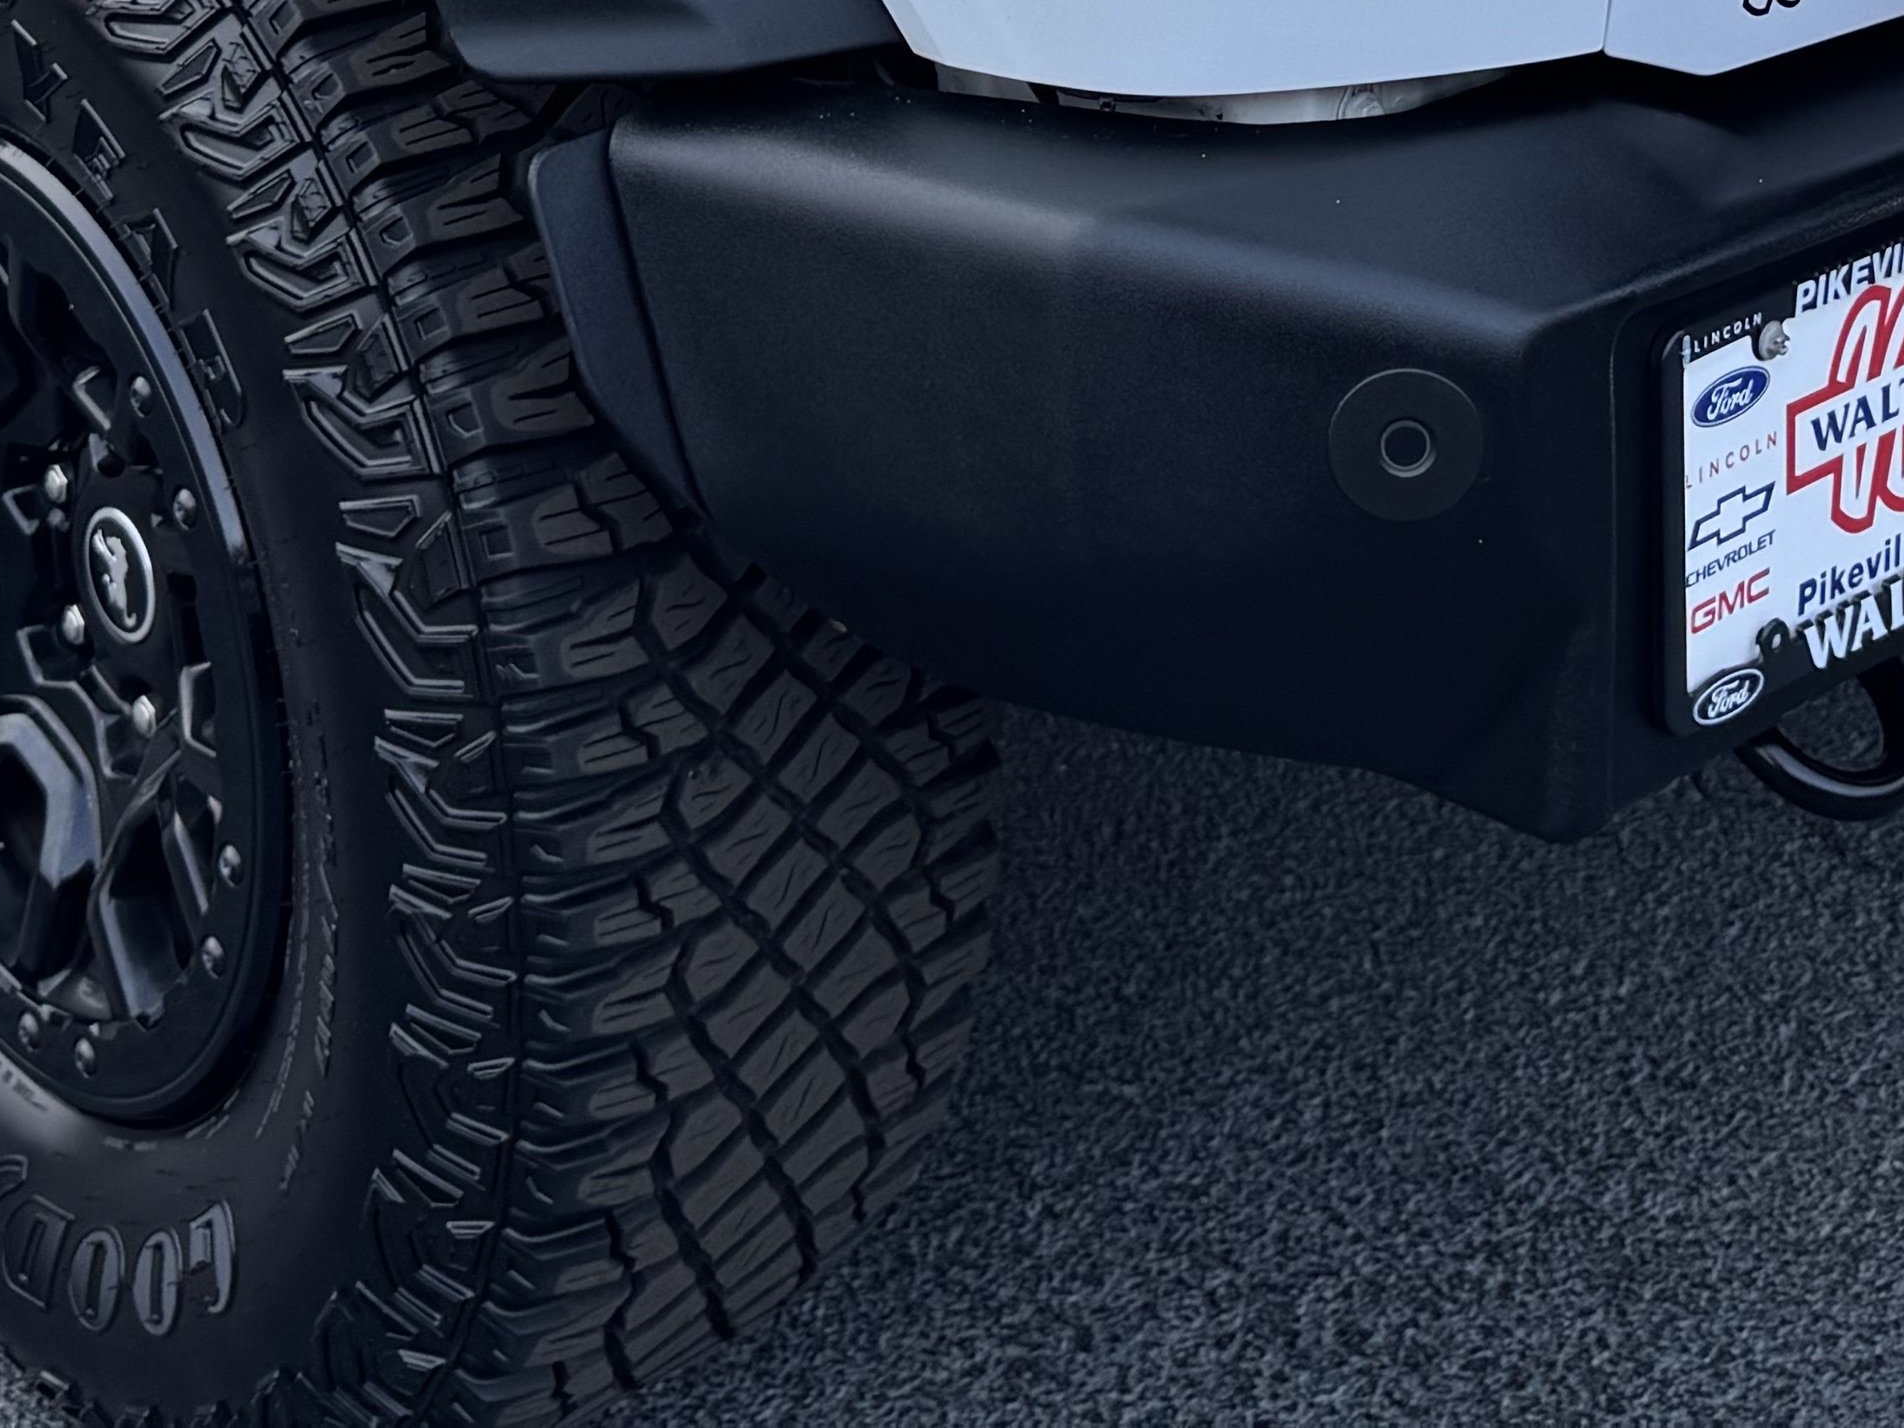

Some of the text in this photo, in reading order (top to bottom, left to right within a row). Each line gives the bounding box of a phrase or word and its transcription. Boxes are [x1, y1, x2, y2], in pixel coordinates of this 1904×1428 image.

[1693, 312, 1763, 354] LINCOLN
[1707, 377, 1754, 421] Ford
[1685, 430, 1778, 490] LINCOLN
[1685, 528, 1777, 589] CHEVROLET
[1690, 567, 1771, 635] GMC
[1707, 679, 1750, 718] Ford
